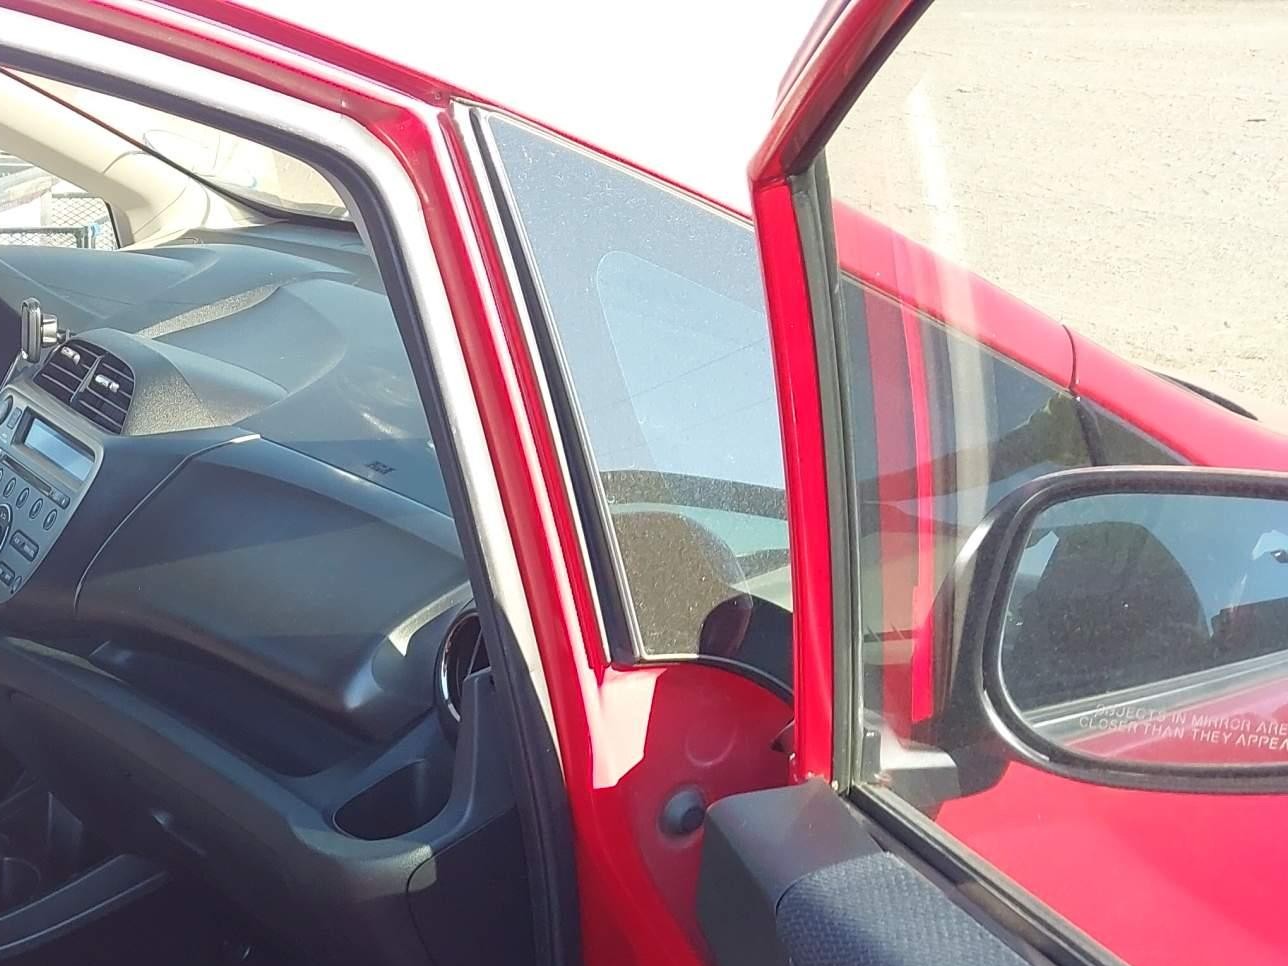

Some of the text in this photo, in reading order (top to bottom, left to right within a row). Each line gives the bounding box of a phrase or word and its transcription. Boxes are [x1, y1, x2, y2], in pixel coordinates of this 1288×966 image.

[1079, 716, 1138, 734] CLOSER
[1144, 722, 1185, 739] THAN
[1191, 728, 1233, 745] THEY
[1094, 703, 1288, 736] OBJECTS IN MIRROR ARE
